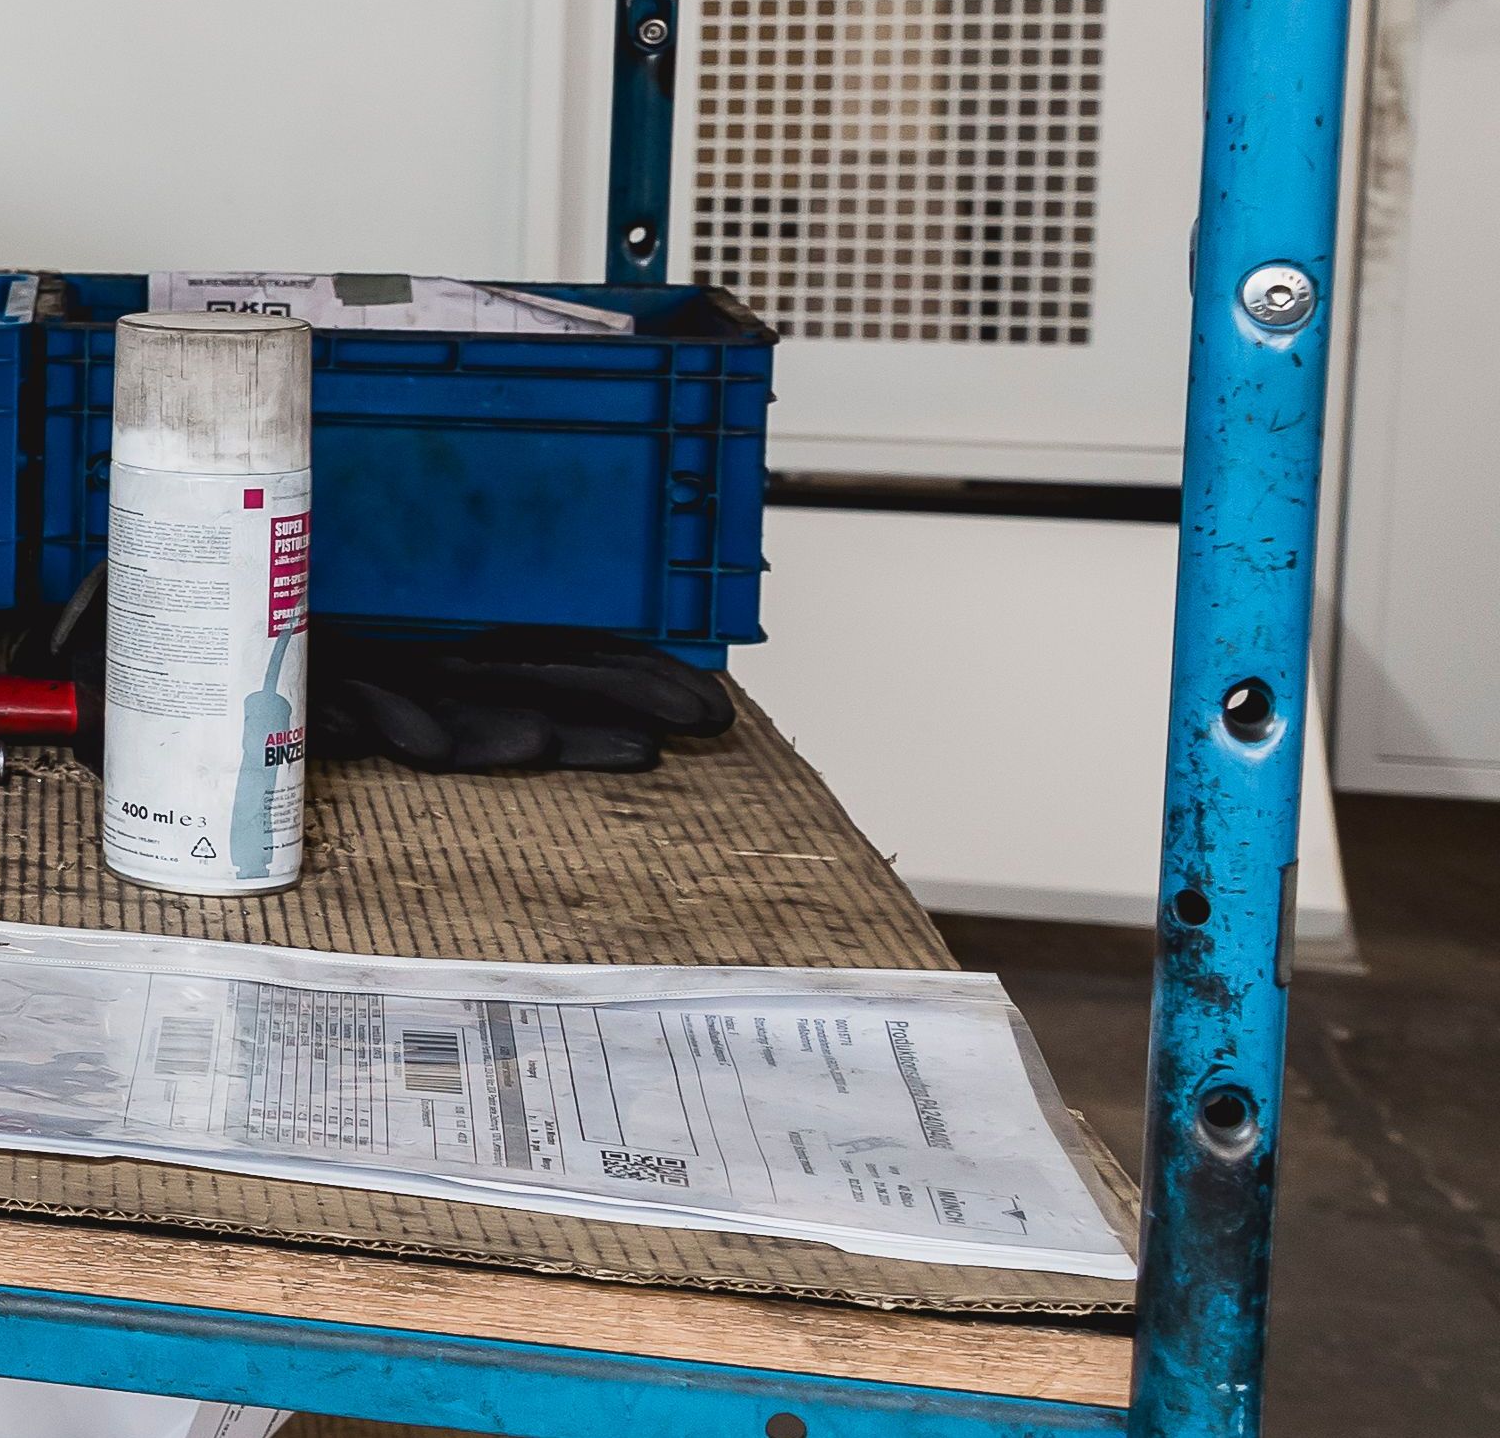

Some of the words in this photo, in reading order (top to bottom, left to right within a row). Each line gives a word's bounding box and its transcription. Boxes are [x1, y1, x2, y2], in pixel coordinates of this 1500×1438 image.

[274, 519, 303, 537] SUPER
[121, 801, 149, 820] 400
[153, 810, 174, 825] ml
